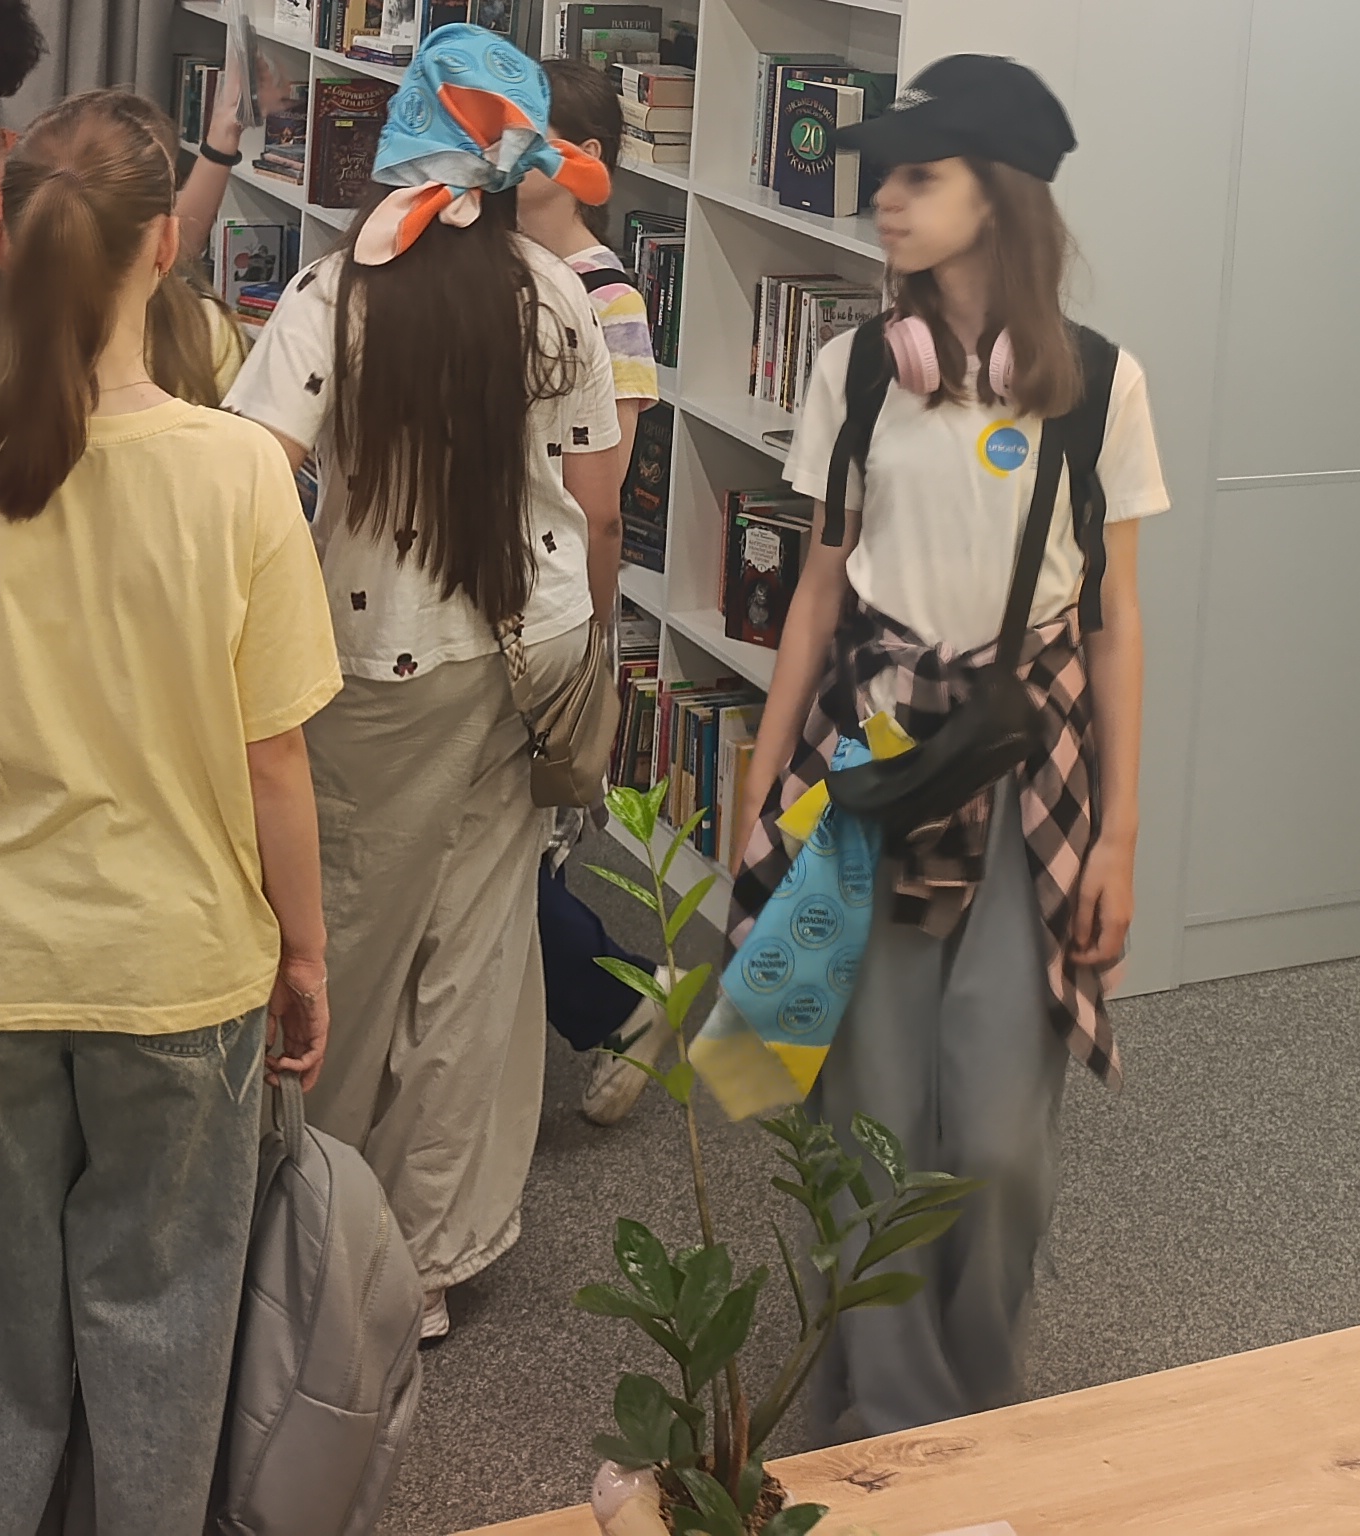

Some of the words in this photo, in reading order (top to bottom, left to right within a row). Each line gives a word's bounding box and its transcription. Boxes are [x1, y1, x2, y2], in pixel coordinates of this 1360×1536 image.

[799, 121, 823, 156] 20
[785, 149, 834, 175] УКРАЇНИ
[800, 916, 835, 926] ВОЛОНТЕР
